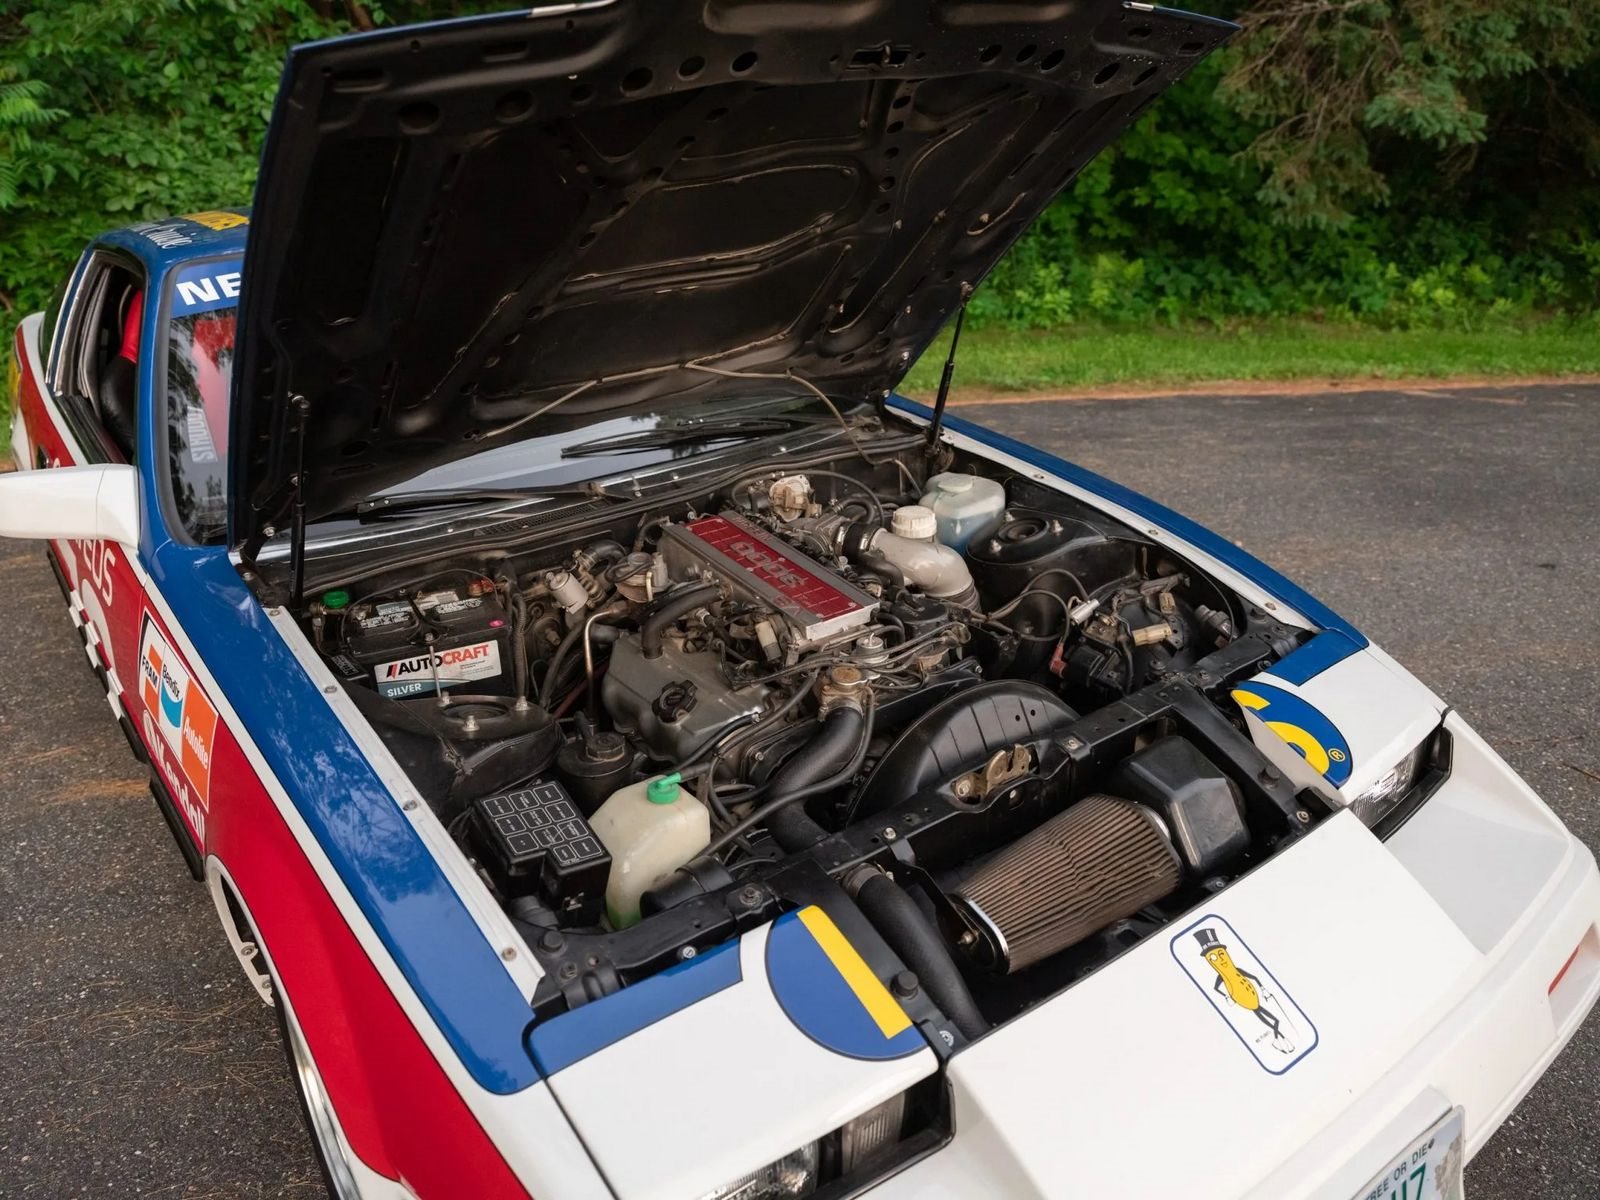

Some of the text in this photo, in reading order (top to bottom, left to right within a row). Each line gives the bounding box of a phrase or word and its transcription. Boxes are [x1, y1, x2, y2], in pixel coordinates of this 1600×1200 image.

[142, 655, 158, 689] FRAM
[398, 644, 489, 676] AUTOCRAFT
[163, 663, 180, 699] Bendix
[387, 683, 422, 697] SILVER
[183, 715, 208, 770] Autolite
[1394, 1162, 1407, 1181] OR
[1412, 1143, 1428, 1164] DIE
